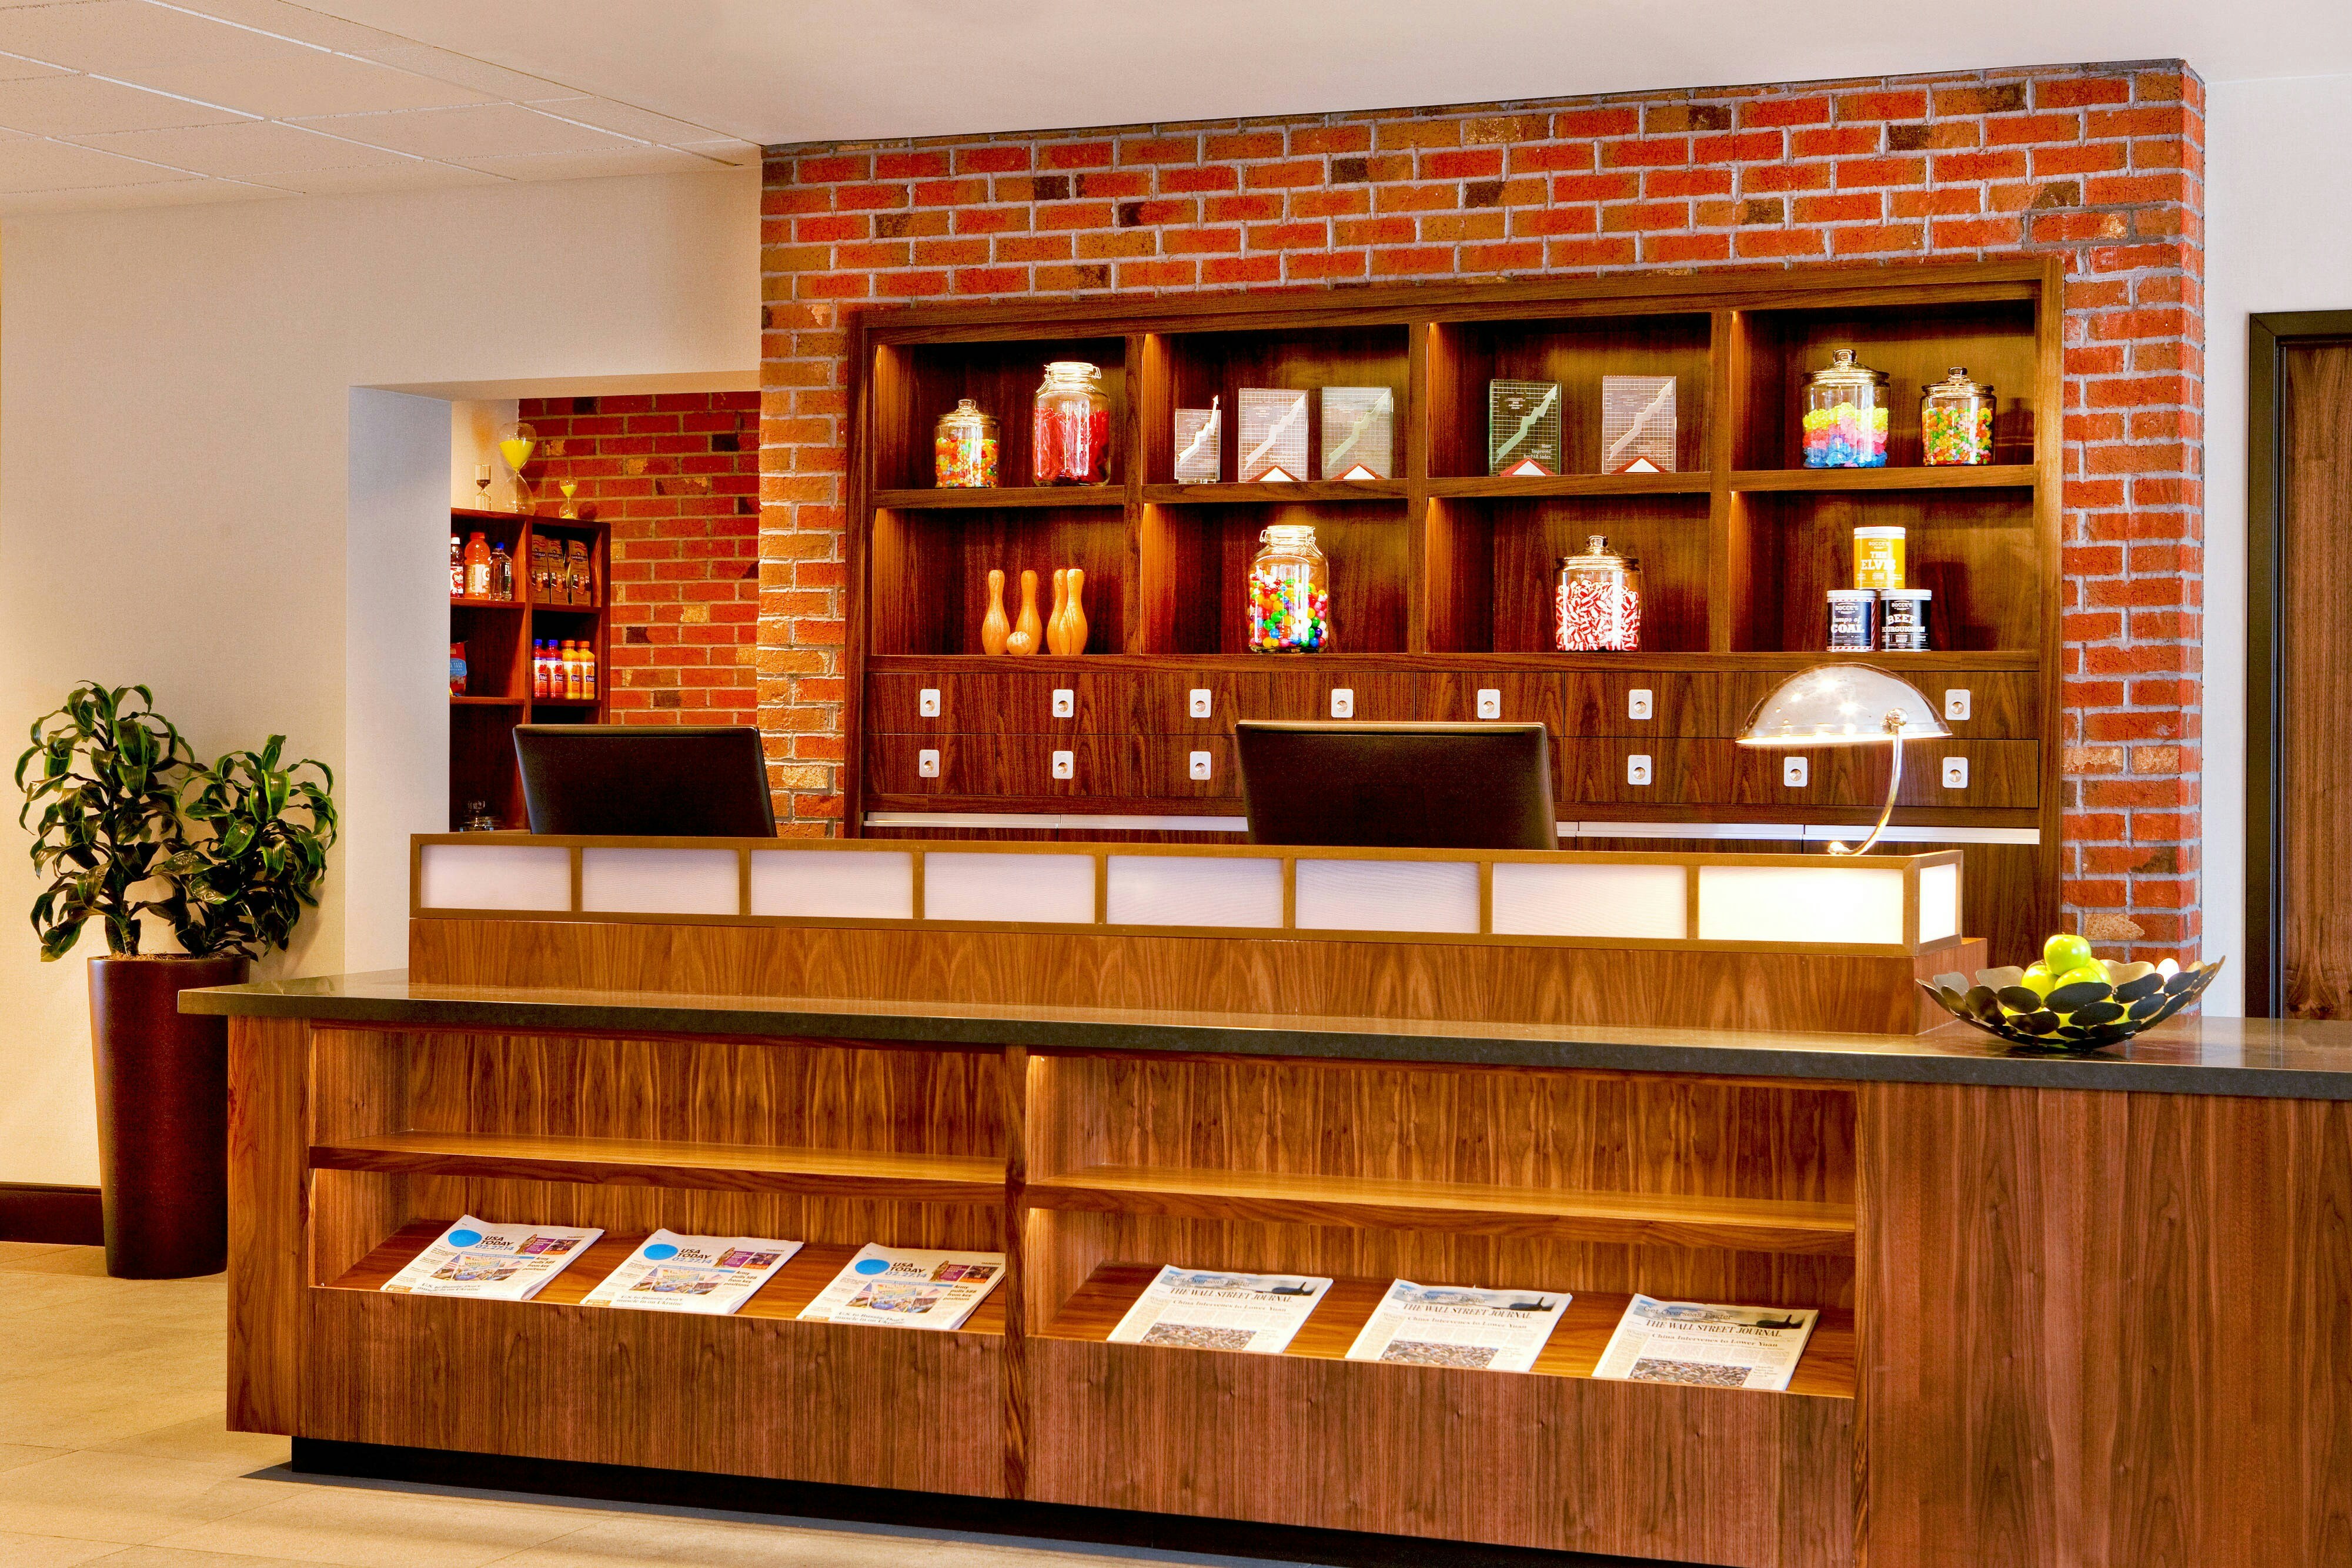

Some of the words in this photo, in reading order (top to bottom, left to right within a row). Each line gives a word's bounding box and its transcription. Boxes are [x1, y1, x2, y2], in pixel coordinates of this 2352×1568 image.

[1861, 559, 1896, 570] ELVIS
[1886, 614, 1918, 625] BEEF
[1831, 624, 1865, 633] COAL
[1425, 1305, 1450, 1313] WALL
[1452, 1307, 1487, 1316] STREET
[1643, 1306, 1660, 1315] Get
[1661, 1308, 1702, 1318] Overseas
[1669, 1322, 1693, 1330] WALL
[1696, 1325, 1735, 1333] STREET
